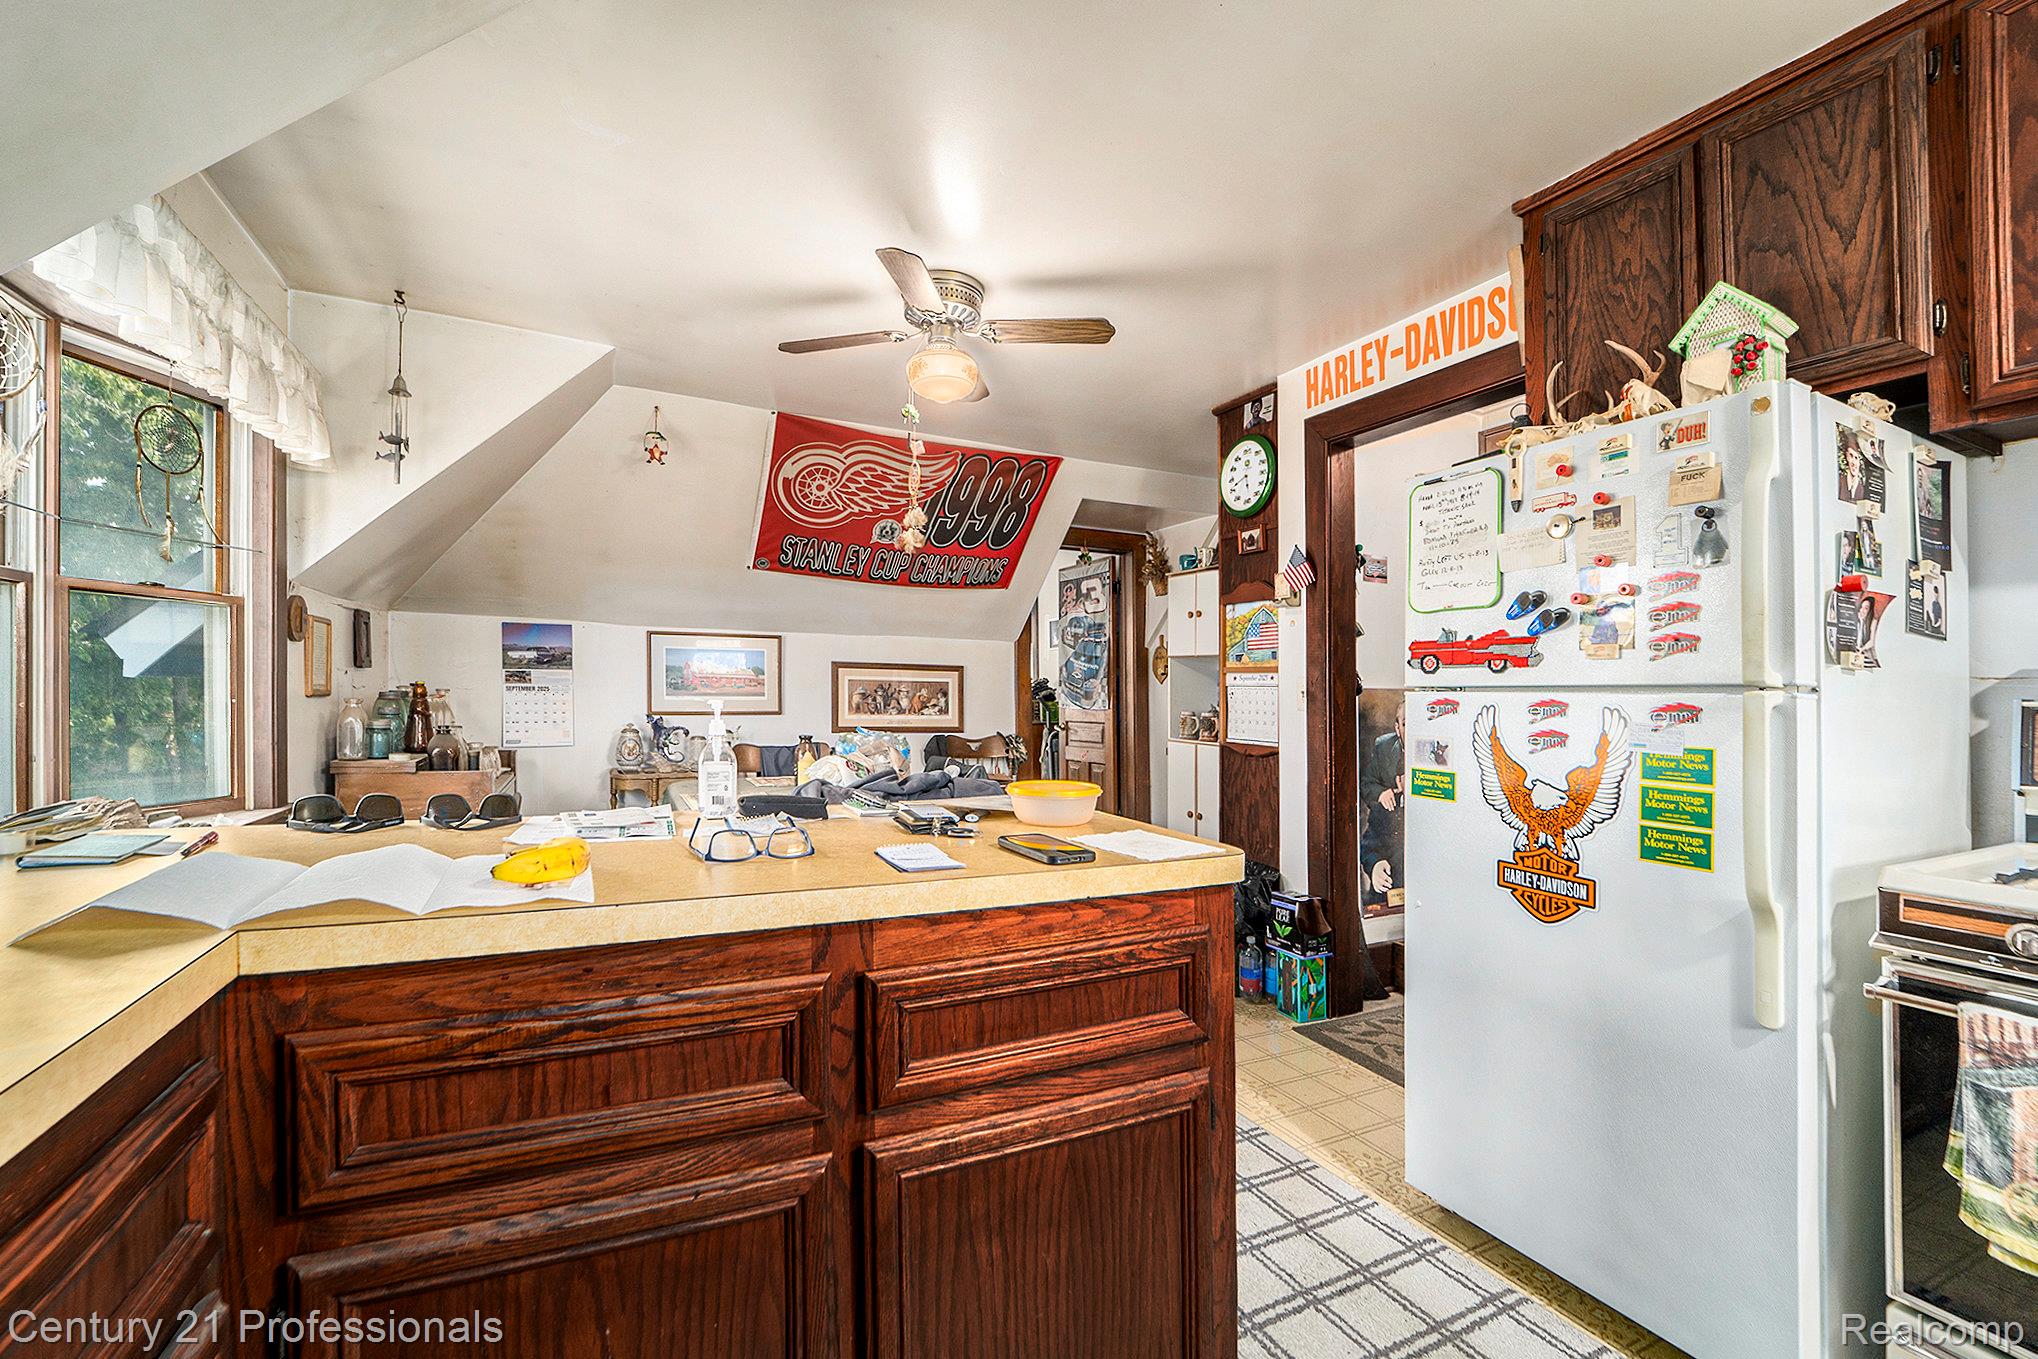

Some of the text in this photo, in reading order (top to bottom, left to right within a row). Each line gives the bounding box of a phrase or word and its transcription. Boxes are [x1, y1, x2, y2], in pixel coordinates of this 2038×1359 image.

[1676, 422, 1707, 444] DUH!
[1680, 471, 1706, 482] FUCK
[922, 452, 1047, 550] 1998
[780, 535, 1007, 585] STANLEY CUP CHAMPIONS
[1081, 579, 1107, 614] 3
[1646, 757, 1709, 771] Motor News
[1413, 777, 1452, 789] Motor News
[1416, 771, 1451, 782] Hemmings
[1645, 798, 1708, 814] Motor News
[1648, 789, 1705, 805] Hemmings
[1644, 837, 1708, 855] Motor News
[1647, 828, 1704, 846] Hemmings
[1523, 853, 1568, 875] MOTOR
[1504, 867, 1588, 900] HARLEY-DAVIDSON
[1523, 890, 1568, 916] CYCLES
